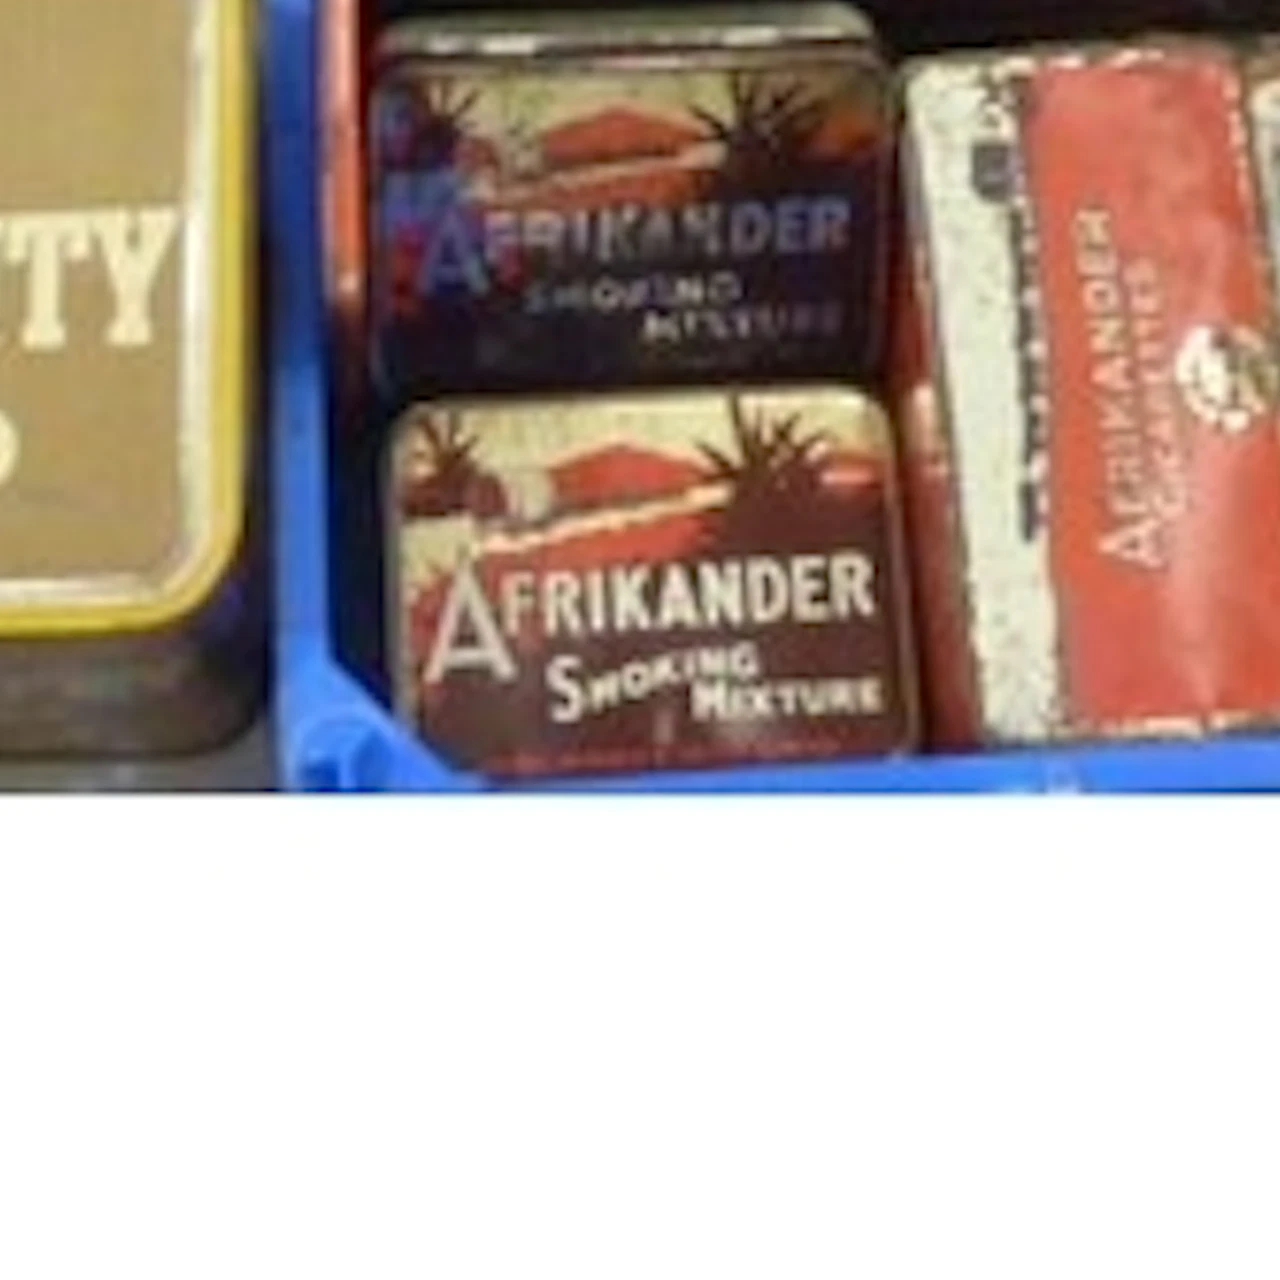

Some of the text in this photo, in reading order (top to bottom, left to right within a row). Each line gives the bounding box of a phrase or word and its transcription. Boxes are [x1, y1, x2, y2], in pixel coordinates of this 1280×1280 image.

[422, 548, 880, 684] AFRIKANDER
[542, 640, 762, 726] SMOKING
[688, 674, 886, 724] MIXTURE
